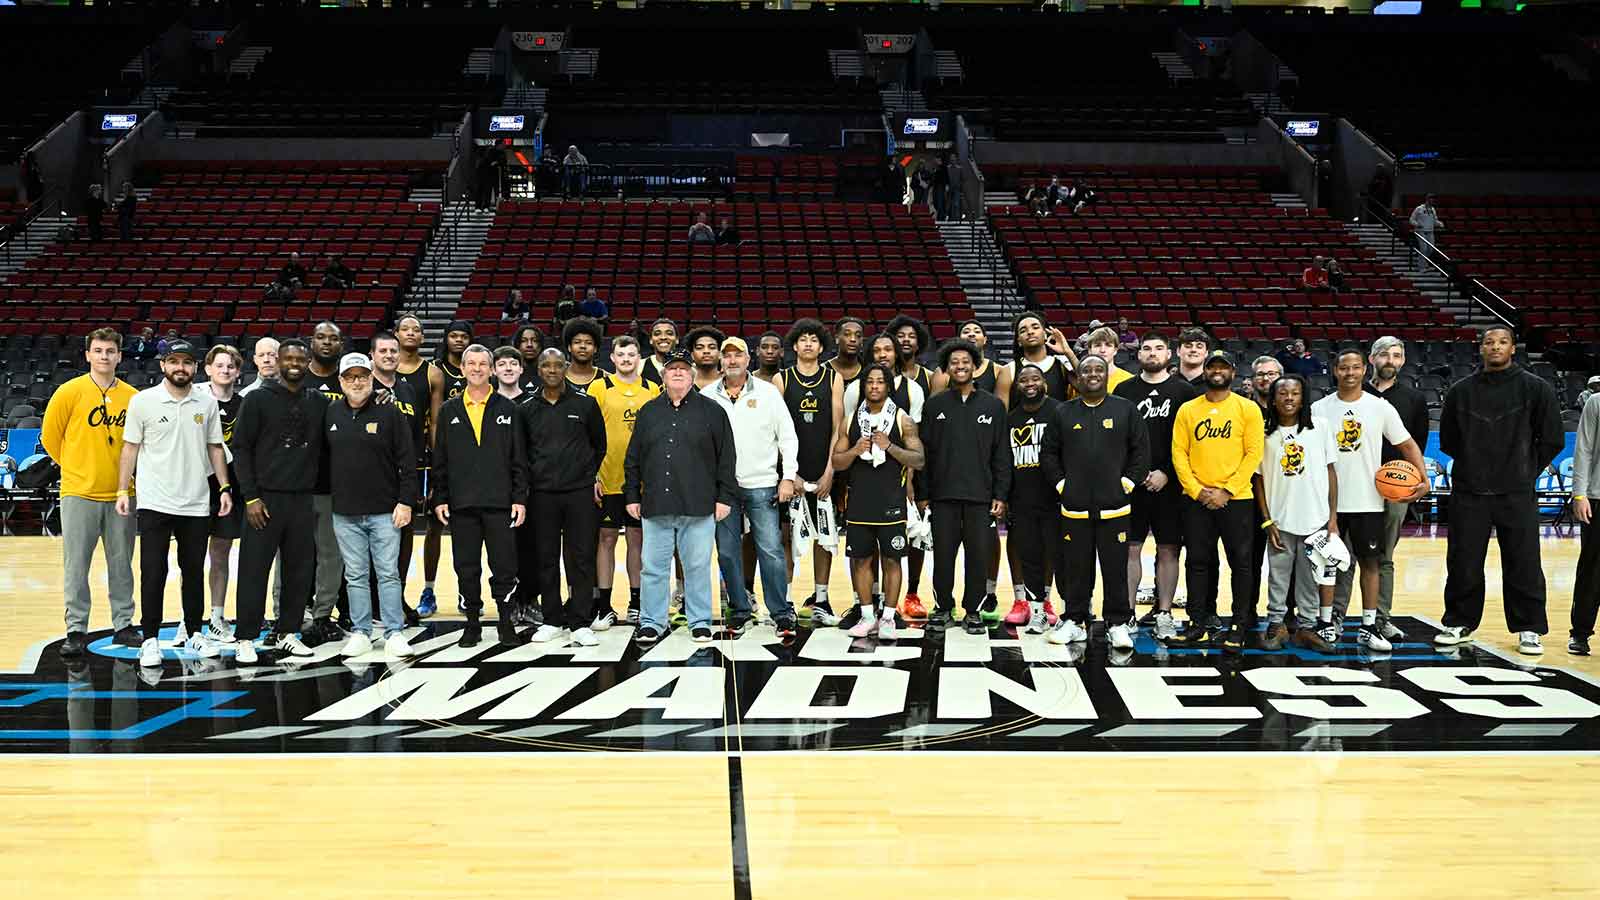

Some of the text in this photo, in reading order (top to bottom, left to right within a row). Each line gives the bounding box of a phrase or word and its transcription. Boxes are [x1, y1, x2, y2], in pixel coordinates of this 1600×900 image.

[88, 405, 127, 428] Owls
[1137, 398, 1171, 419] Owls
[1194, 418, 1232, 441] Owls
[1384, 471, 1407, 480] NCAA
[276, 625, 1072, 663] MARCH
[301, 666, 1600, 719] MADNESS
